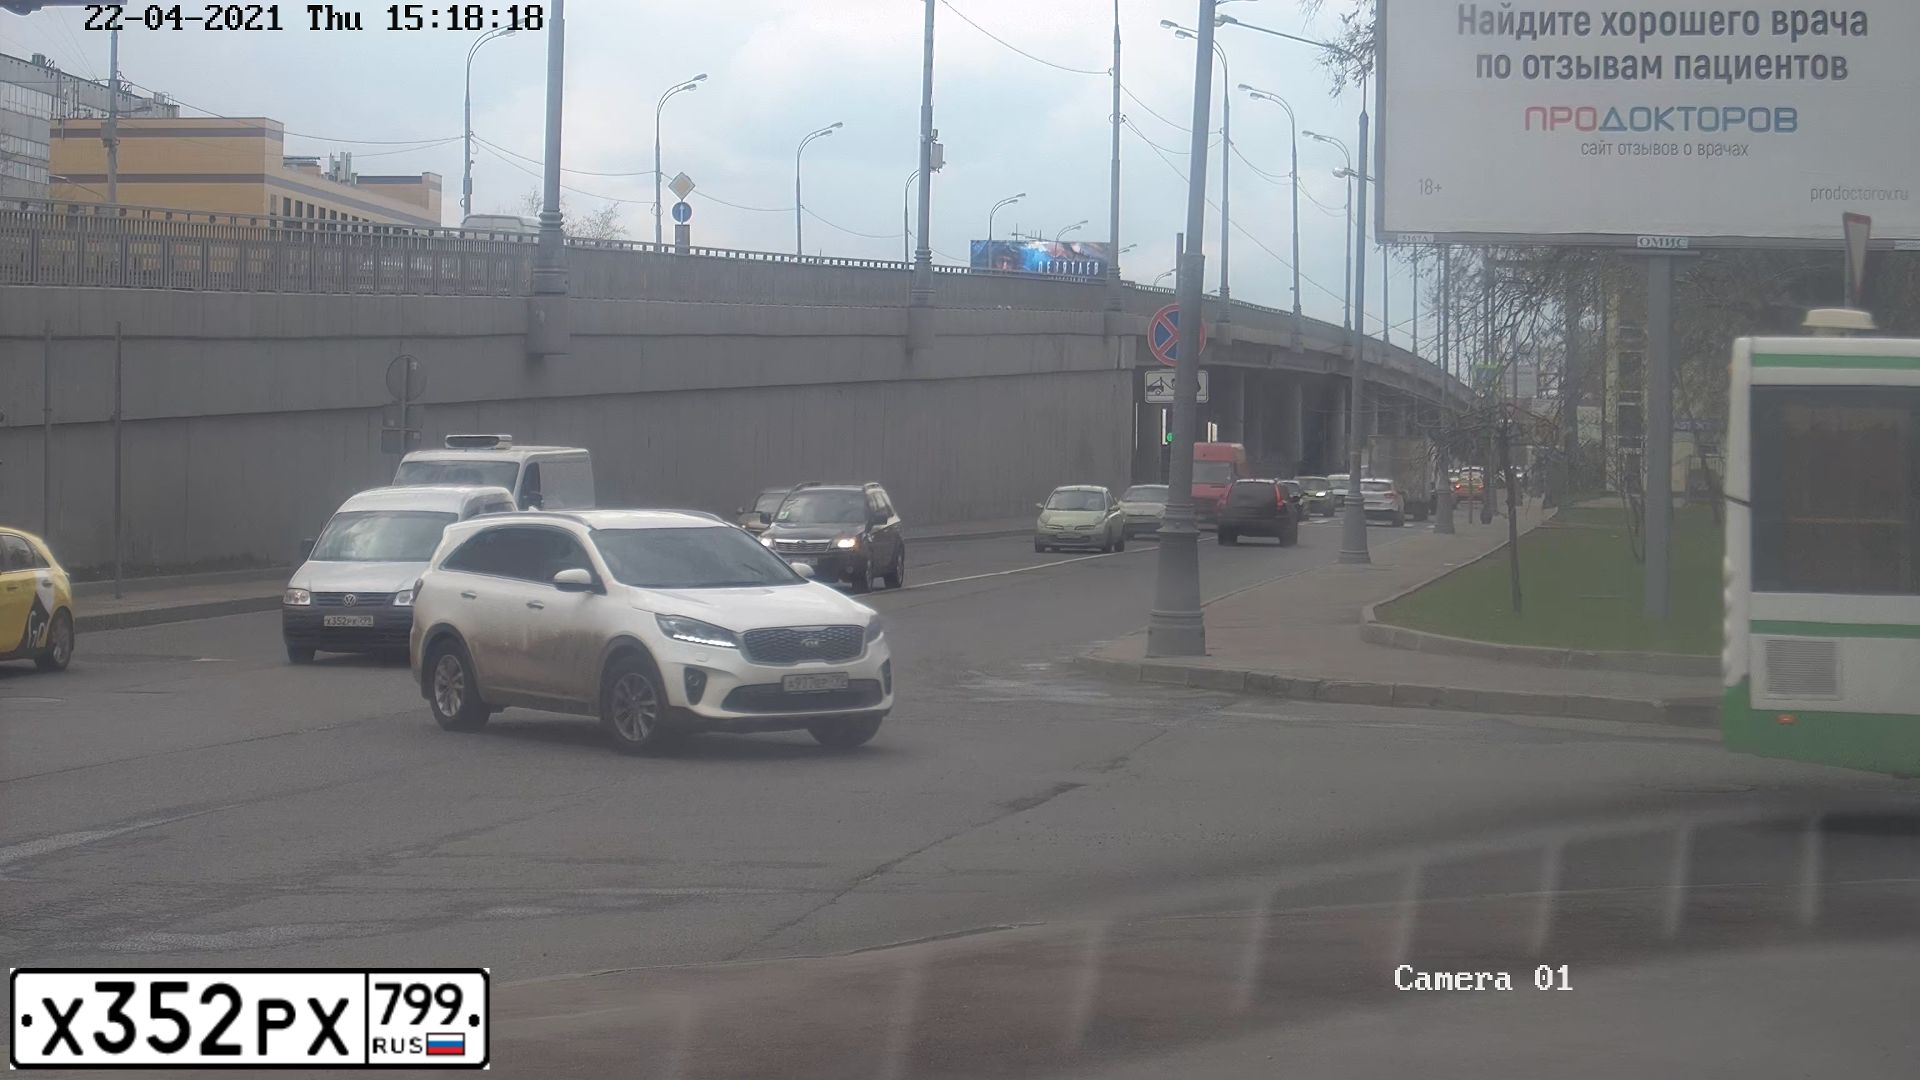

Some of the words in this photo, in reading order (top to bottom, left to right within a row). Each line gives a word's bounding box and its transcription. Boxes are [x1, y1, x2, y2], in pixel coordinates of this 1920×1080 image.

[1457, 2, 1591, 41] Найдите
[1600, 10, 1760, 44] хорошего
[1771, 9, 1868, 43] врача
[1476, 53, 1511, 79] по
[1522, 54, 1662, 80] отзывам
[1674, 53, 1848, 84] пациентов
[1525, 106, 1798, 133] ПРОДОКТОРОВ
[1580, 139, 1613, 156] сайт
[1617, 142, 1679, 156] отзывов
[1683, 143, 1692, 156] о
[1697, 143, 1749, 160] врачах
[1418, 178, 1443, 195] 18+
[1810, 186, 1908, 202] prodoctorov.ru
